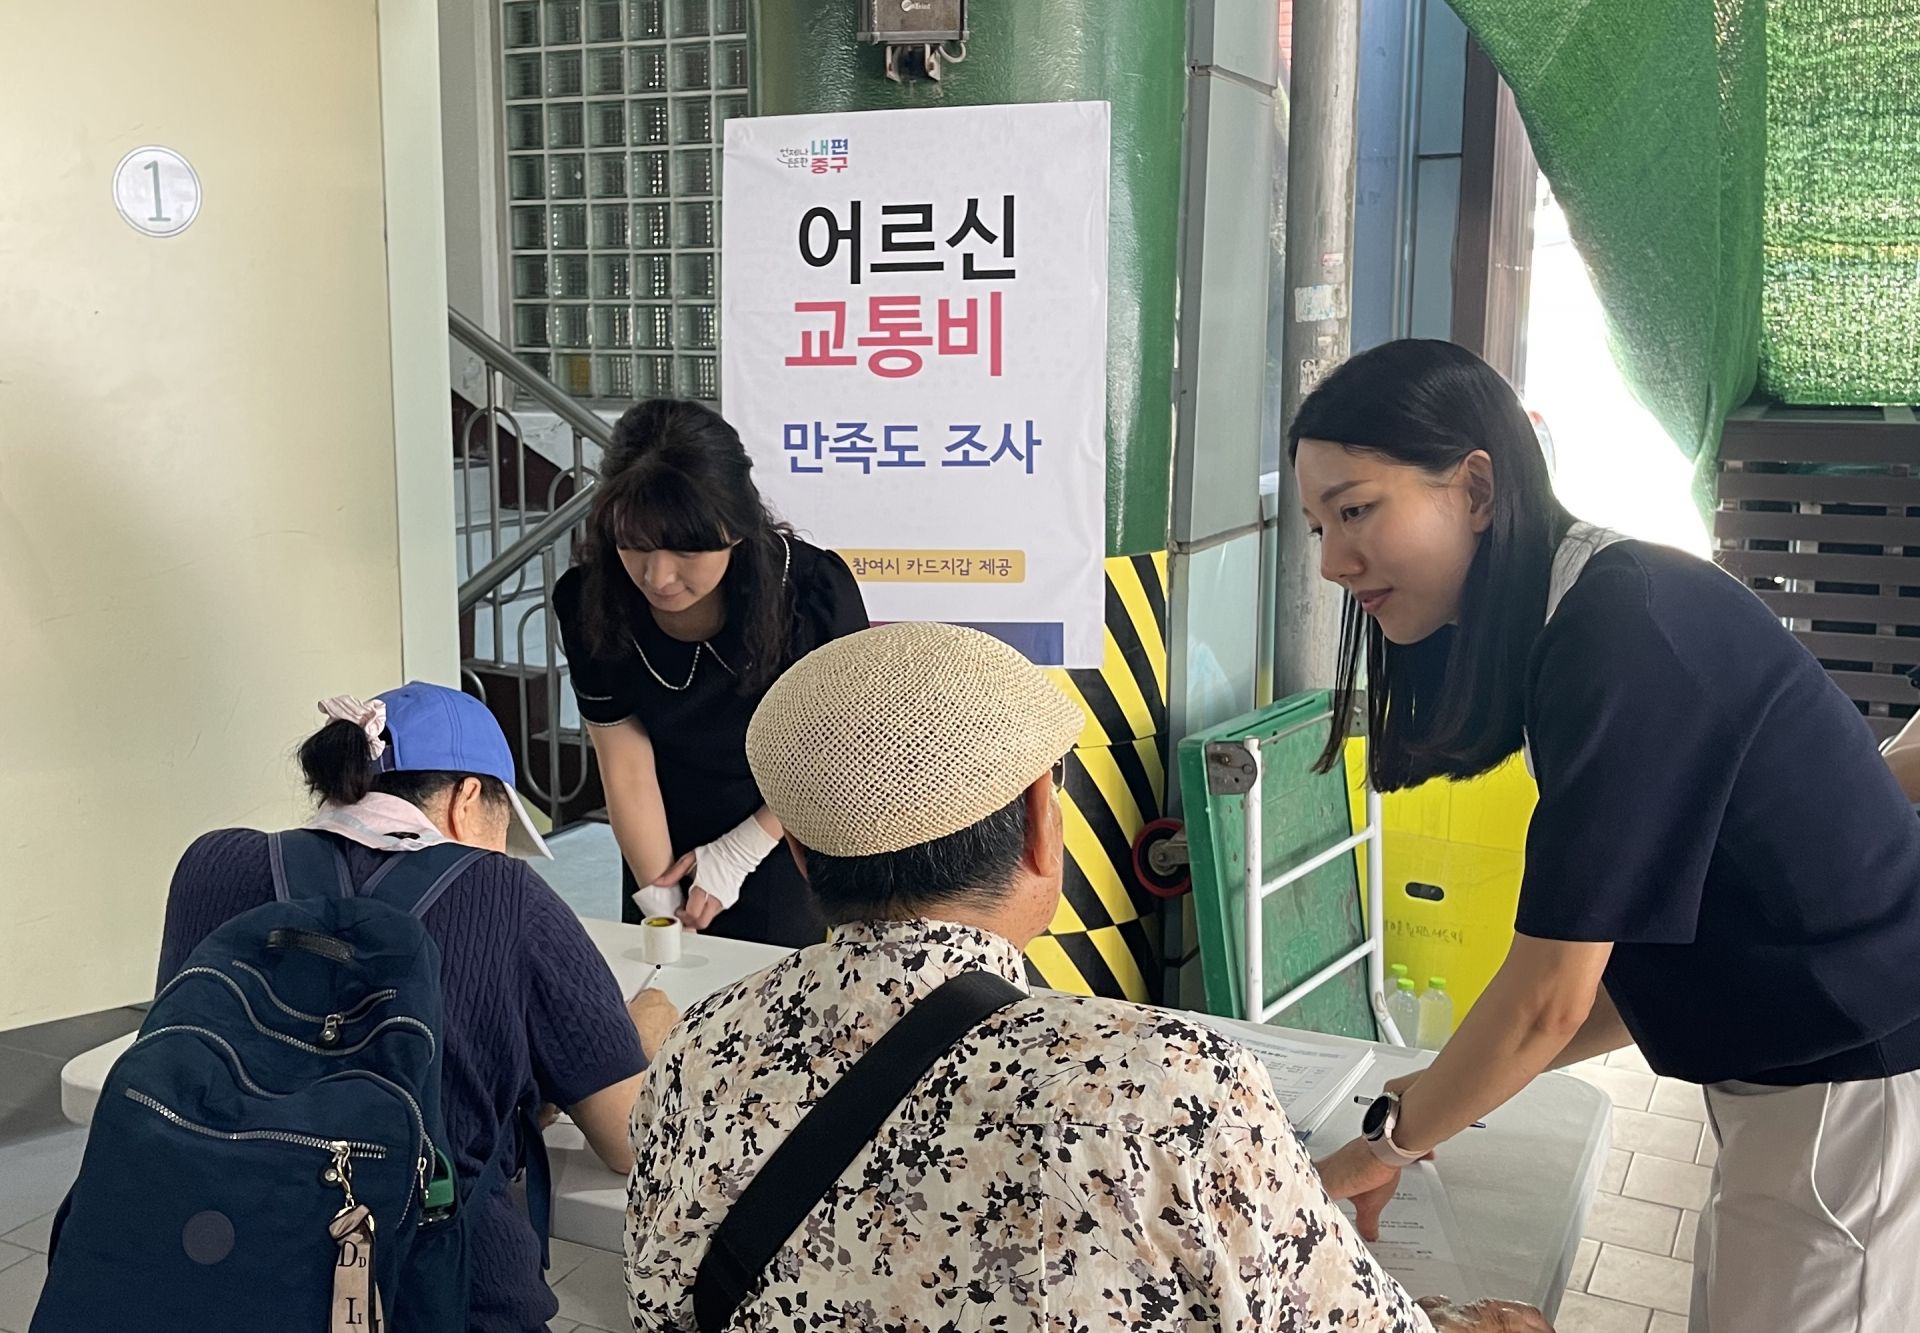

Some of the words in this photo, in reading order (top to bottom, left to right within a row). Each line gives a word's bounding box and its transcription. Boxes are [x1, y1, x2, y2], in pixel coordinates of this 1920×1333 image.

[780, 148, 808, 158] 언제나
[811, 139, 848, 156] 내편
[811, 157, 848, 174] 중구
[143, 160, 171, 222] 1
[799, 195, 1016, 285] 어르신
[785, 291, 1003, 379] 교통비
[784, 421, 926, 475] 만족도
[941, 420, 1042, 474] 조사
[852, 557, 900, 576] 참여시
[907, 557, 972, 576] 카드지갑
[979, 558, 1012, 577] 제공
